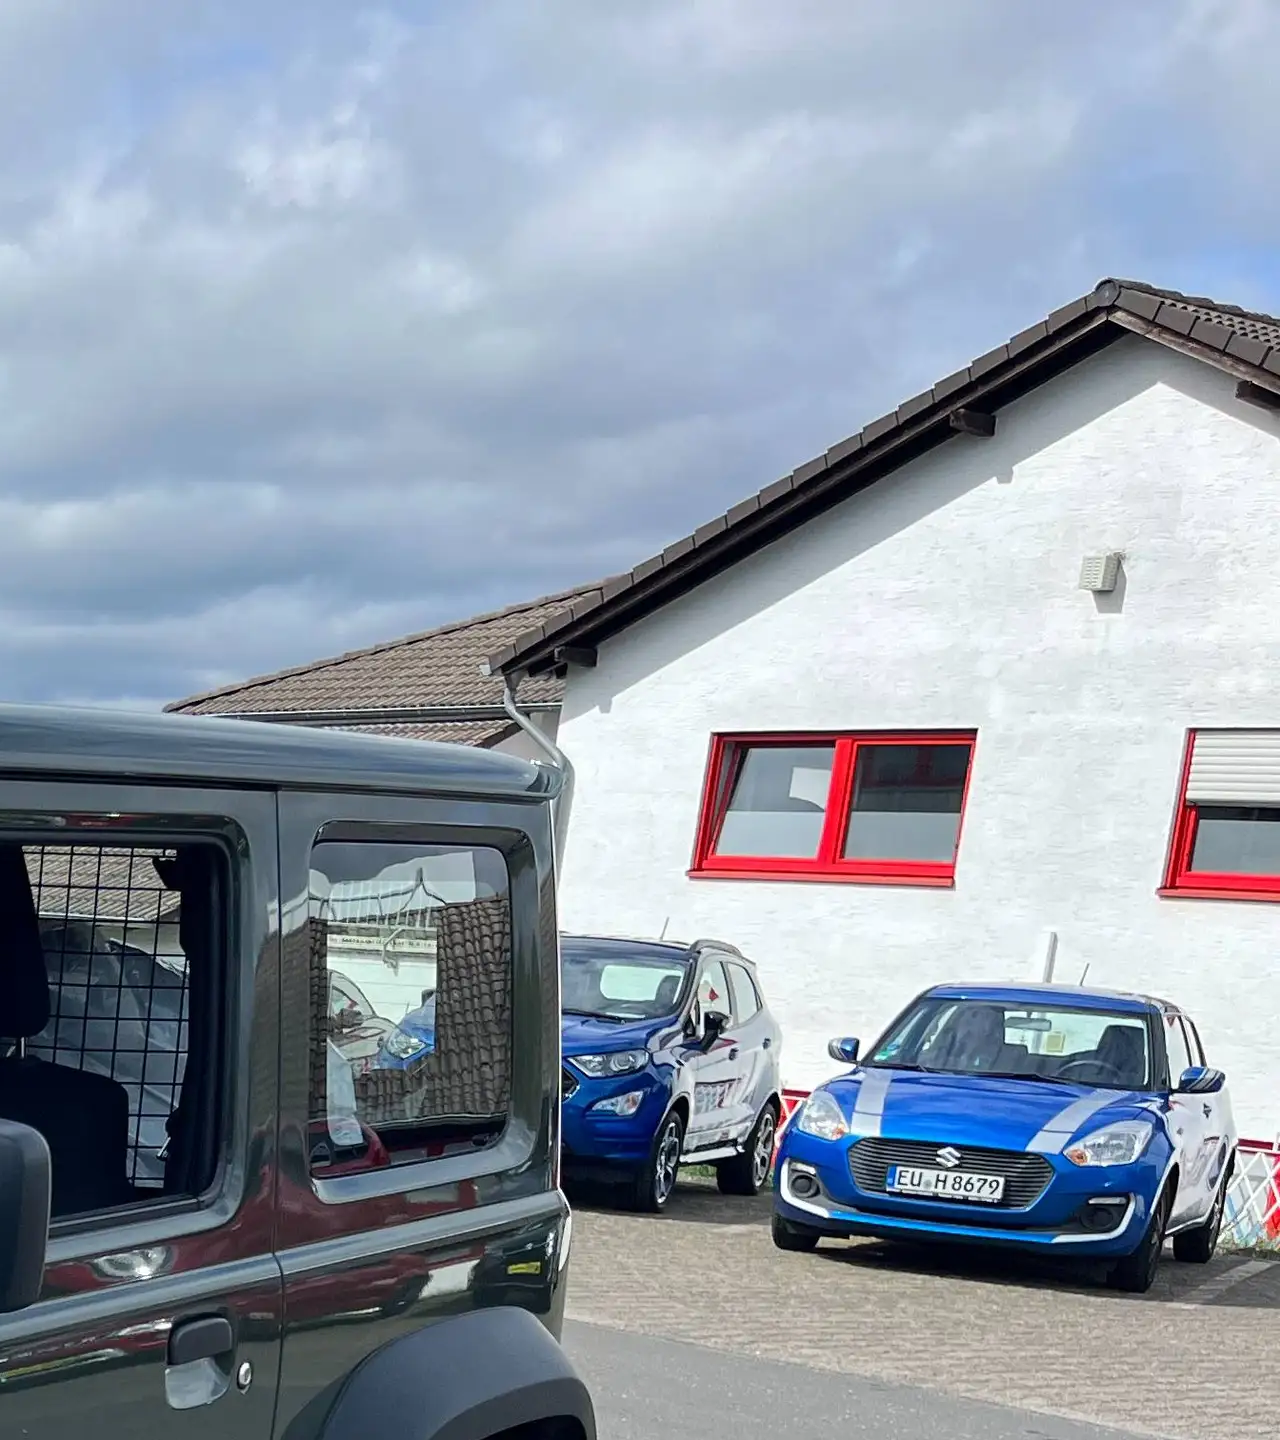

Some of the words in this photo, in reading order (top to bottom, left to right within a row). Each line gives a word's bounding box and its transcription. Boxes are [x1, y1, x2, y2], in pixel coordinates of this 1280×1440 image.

[897, 1170, 923, 1187] EU
[934, 1173, 948, 1190] H
[952, 1176, 1000, 1195] 8679
